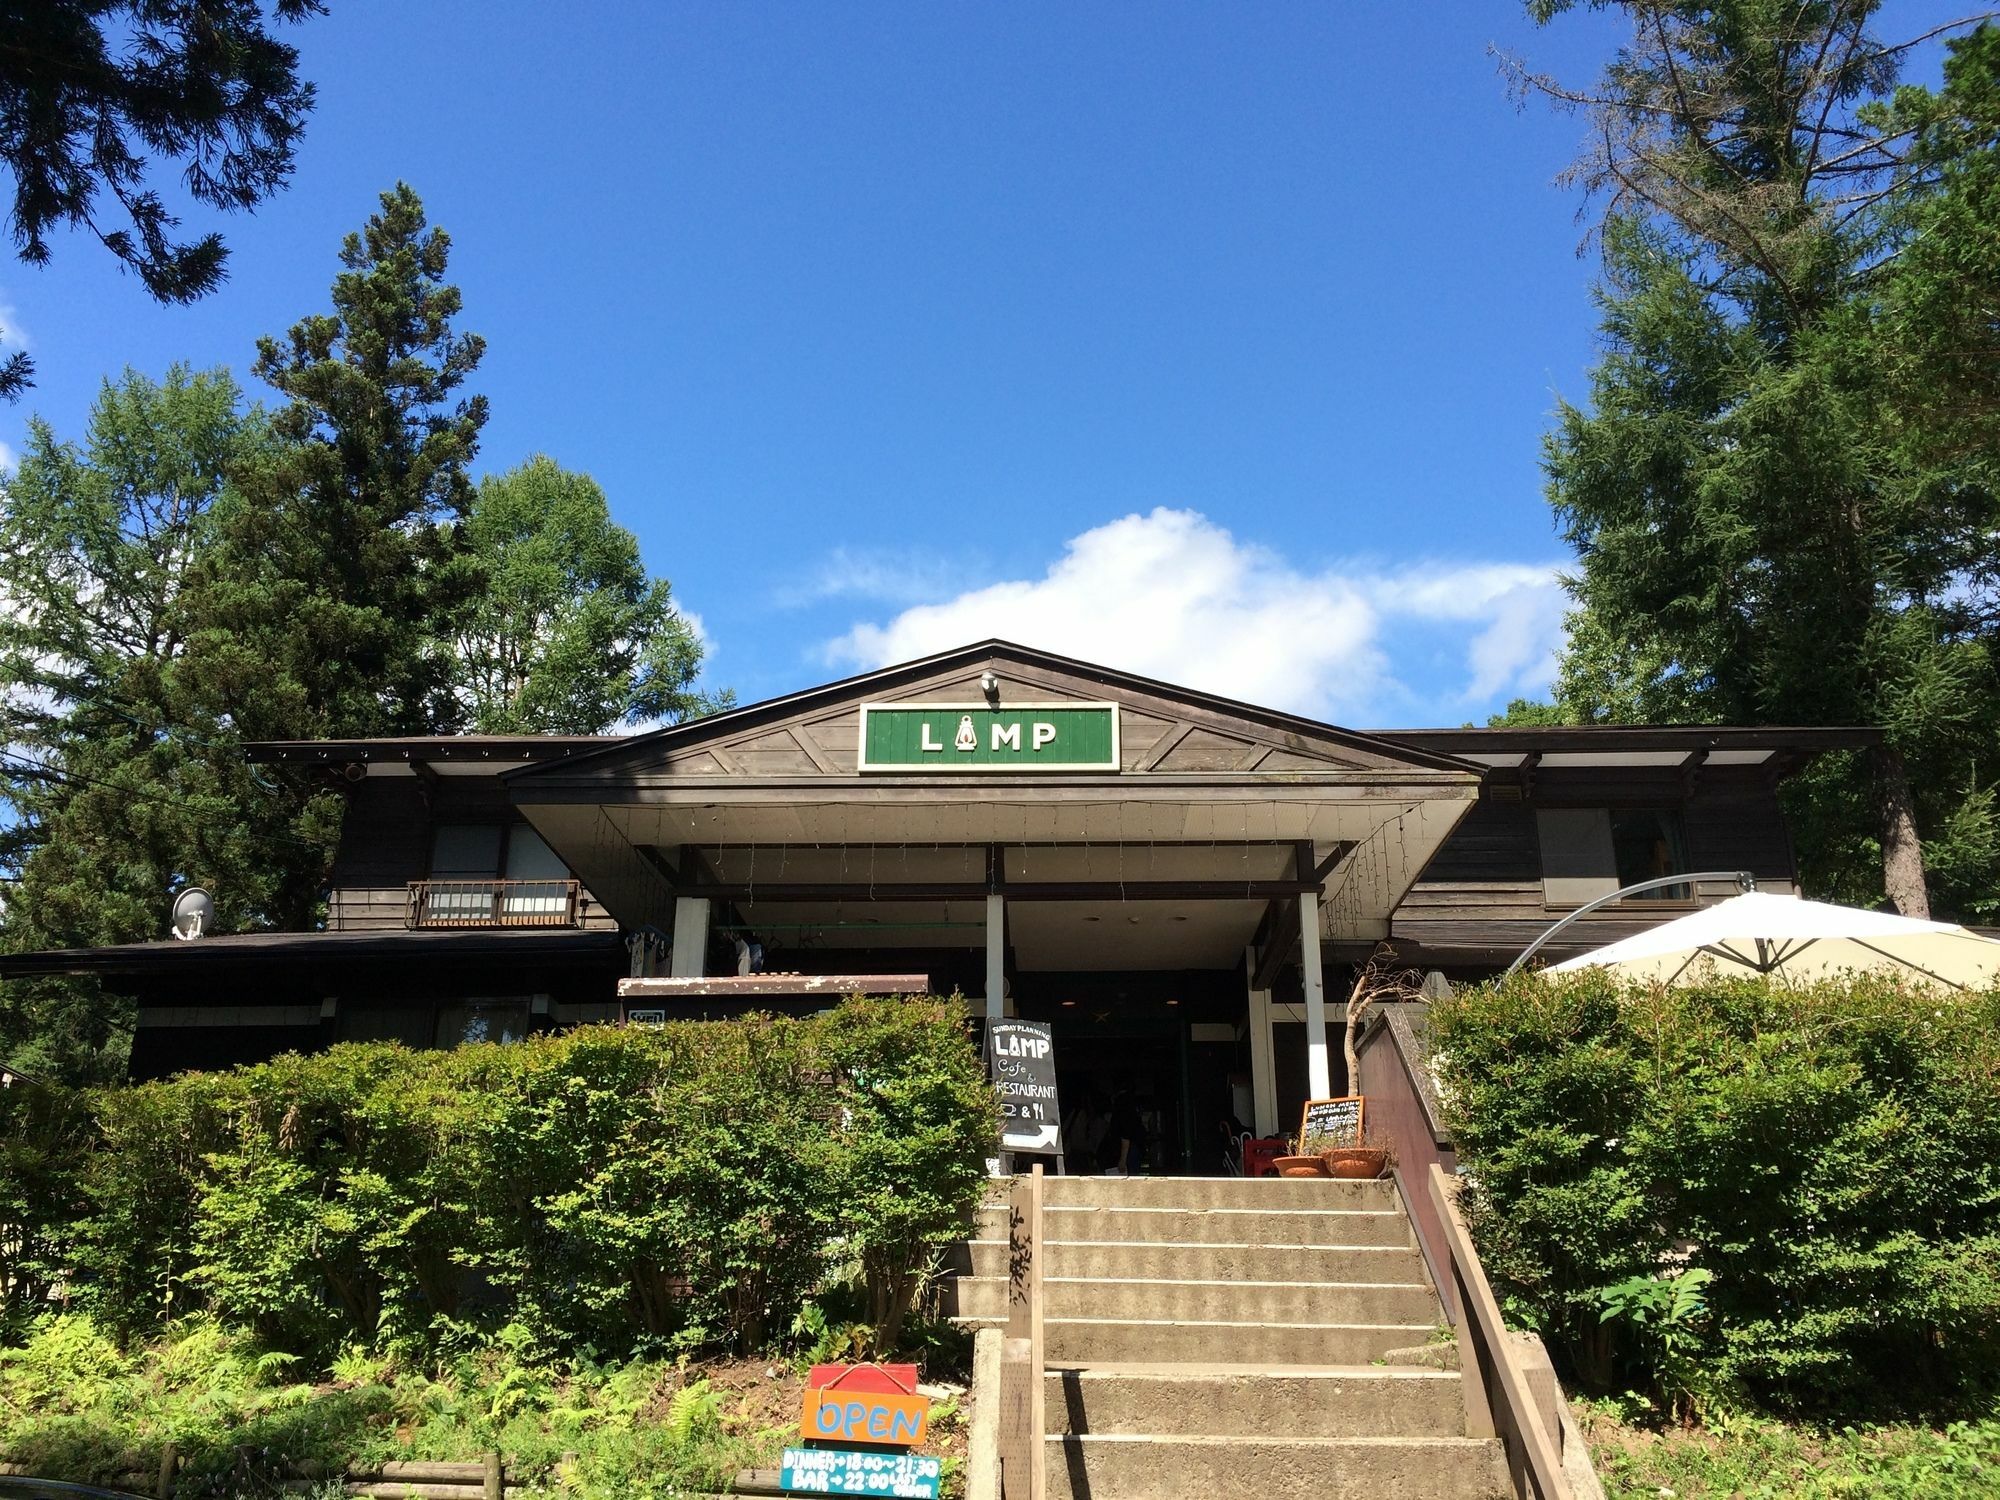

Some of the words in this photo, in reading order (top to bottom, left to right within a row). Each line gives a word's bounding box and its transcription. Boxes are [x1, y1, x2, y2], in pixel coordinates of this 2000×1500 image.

[993, 1024, 1016, 1034] SUNDAY
[1017, 1024, 1050, 1041] PLANNING
[998, 1059, 1027, 1077] Cafe
[996, 1081, 1056, 1099] RESTAURANT
[817, 1402, 921, 1439] OPEN
[783, 1451, 836, 1473] DINNER
[791, 1469, 829, 1492] BAR
[843, 1471, 890, 1491] 22:00
[889, 1472, 918, 1486] LAST
